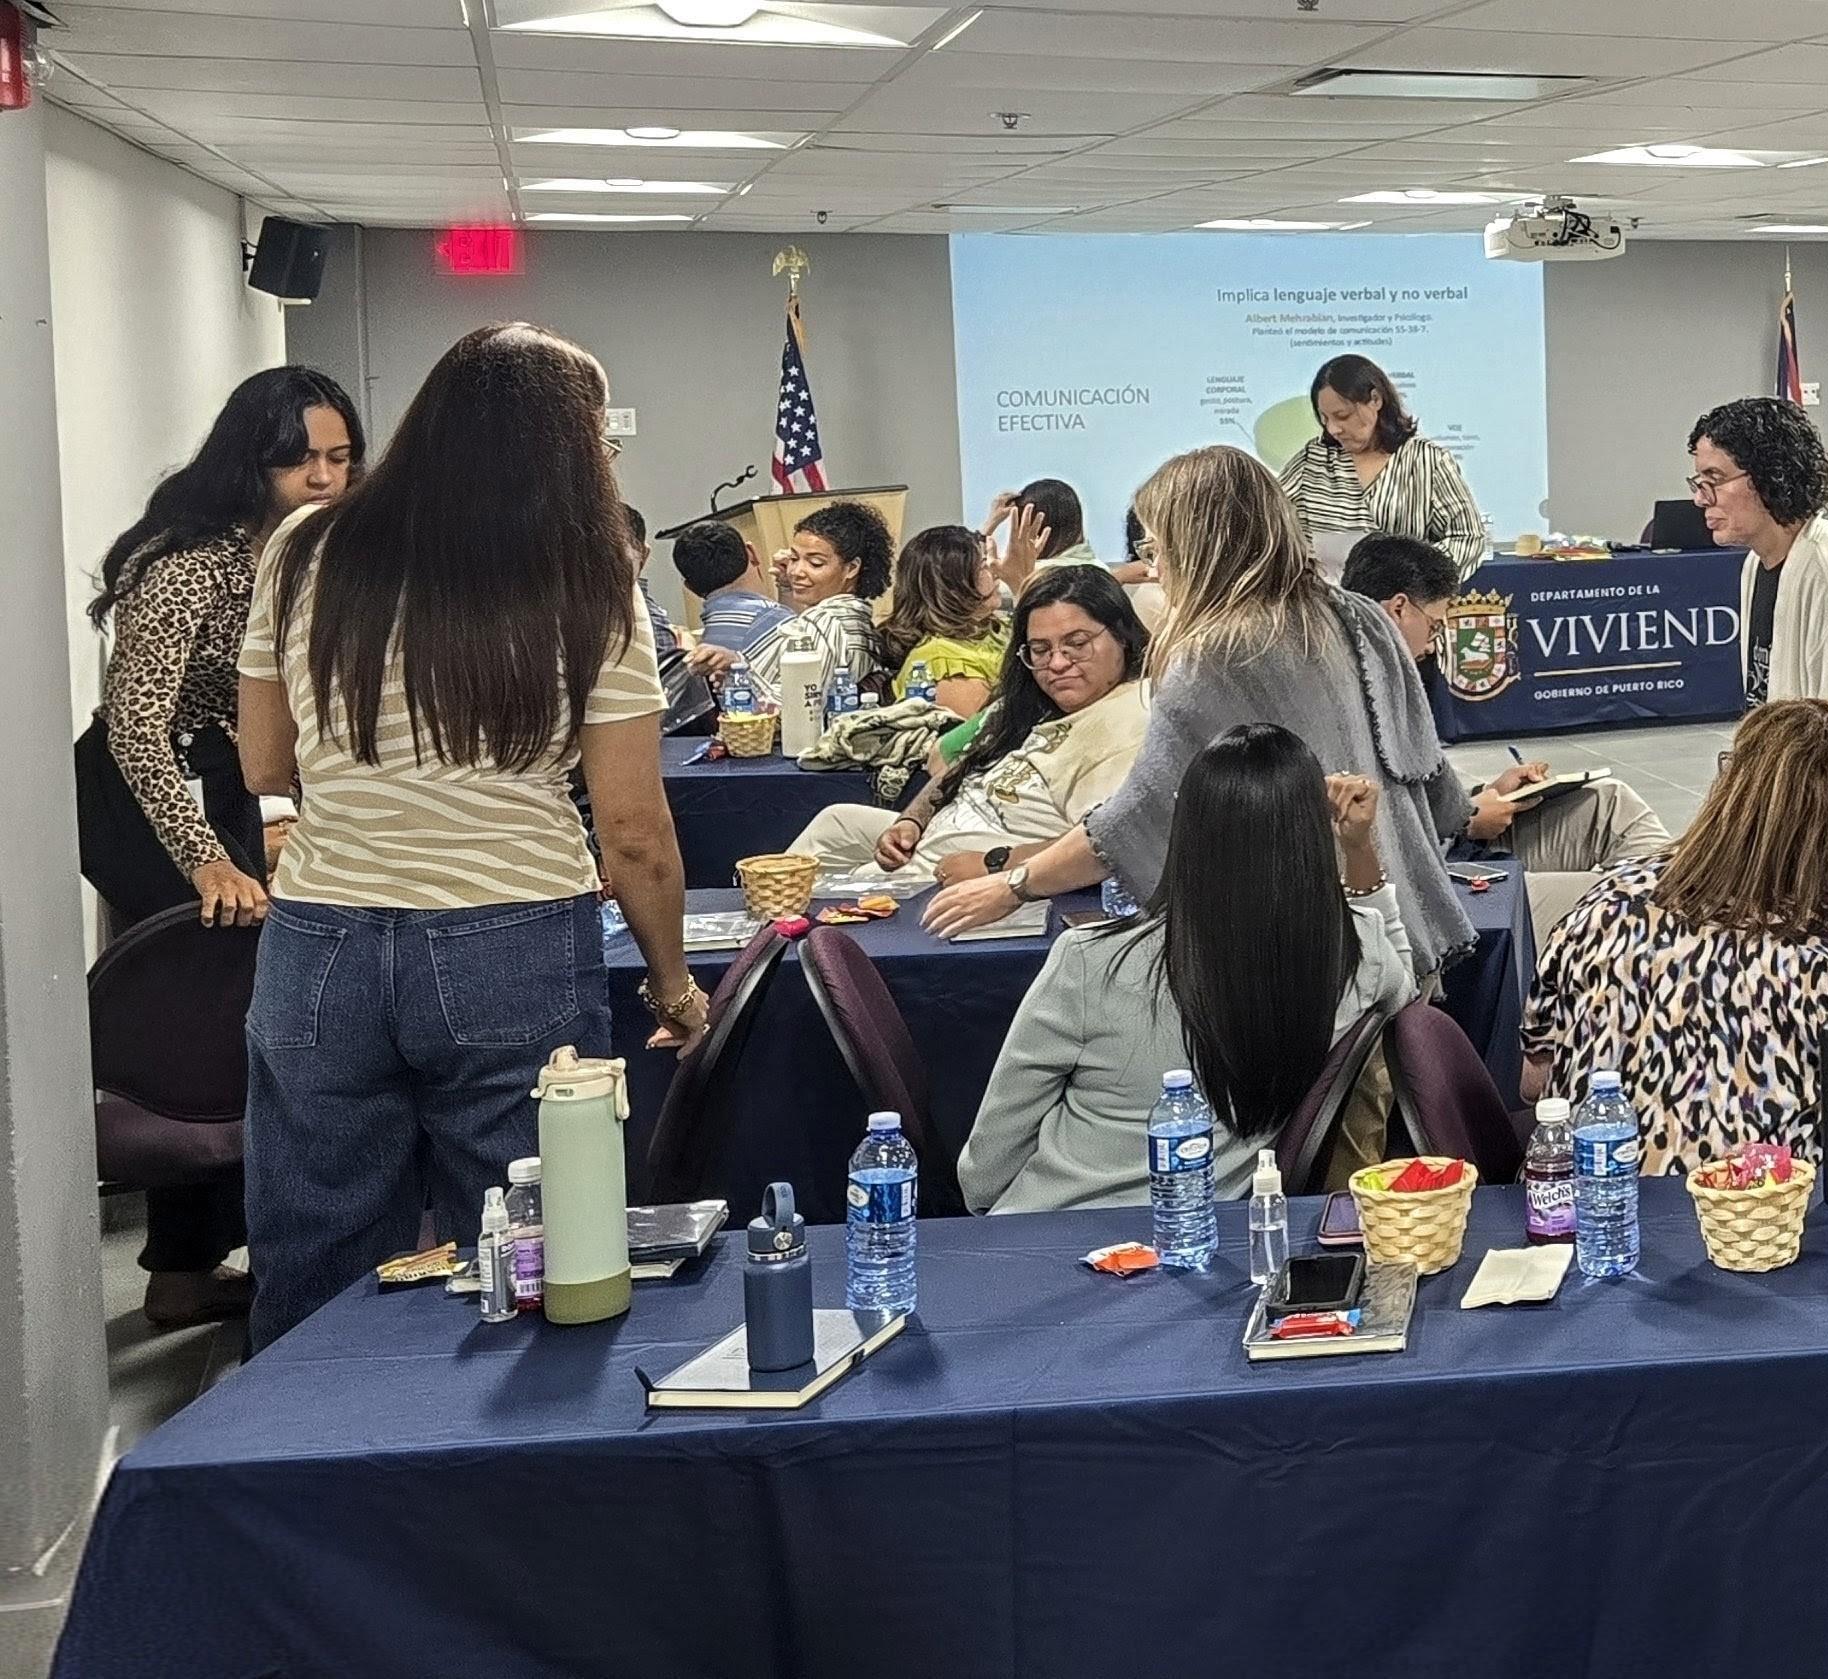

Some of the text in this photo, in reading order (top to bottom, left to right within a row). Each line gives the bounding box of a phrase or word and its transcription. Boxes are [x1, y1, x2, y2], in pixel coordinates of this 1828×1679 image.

[1217, 286, 1468, 304] Implica lenguaje verbal y no verbal
[1245, 314, 1277, 323] Albert
[1285, 327, 1293, 335] el
[1294, 327, 1325, 335] modelo
[1327, 327, 1337, 335] de
[1340, 326, 1394, 334] comunicación
[997, 384, 1150, 408] COMUNICACIÓN
[998, 413, 1086, 432] EFECTIVA
[1530, 585, 1661, 602] DEPARTAMENTO DE LA
[1526, 605, 1740, 658] VIVIEND
[1534, 679, 1685, 700] GOBIERNO DE PUERTO RICO
[1533, 1185, 1572, 1206] Welch's
